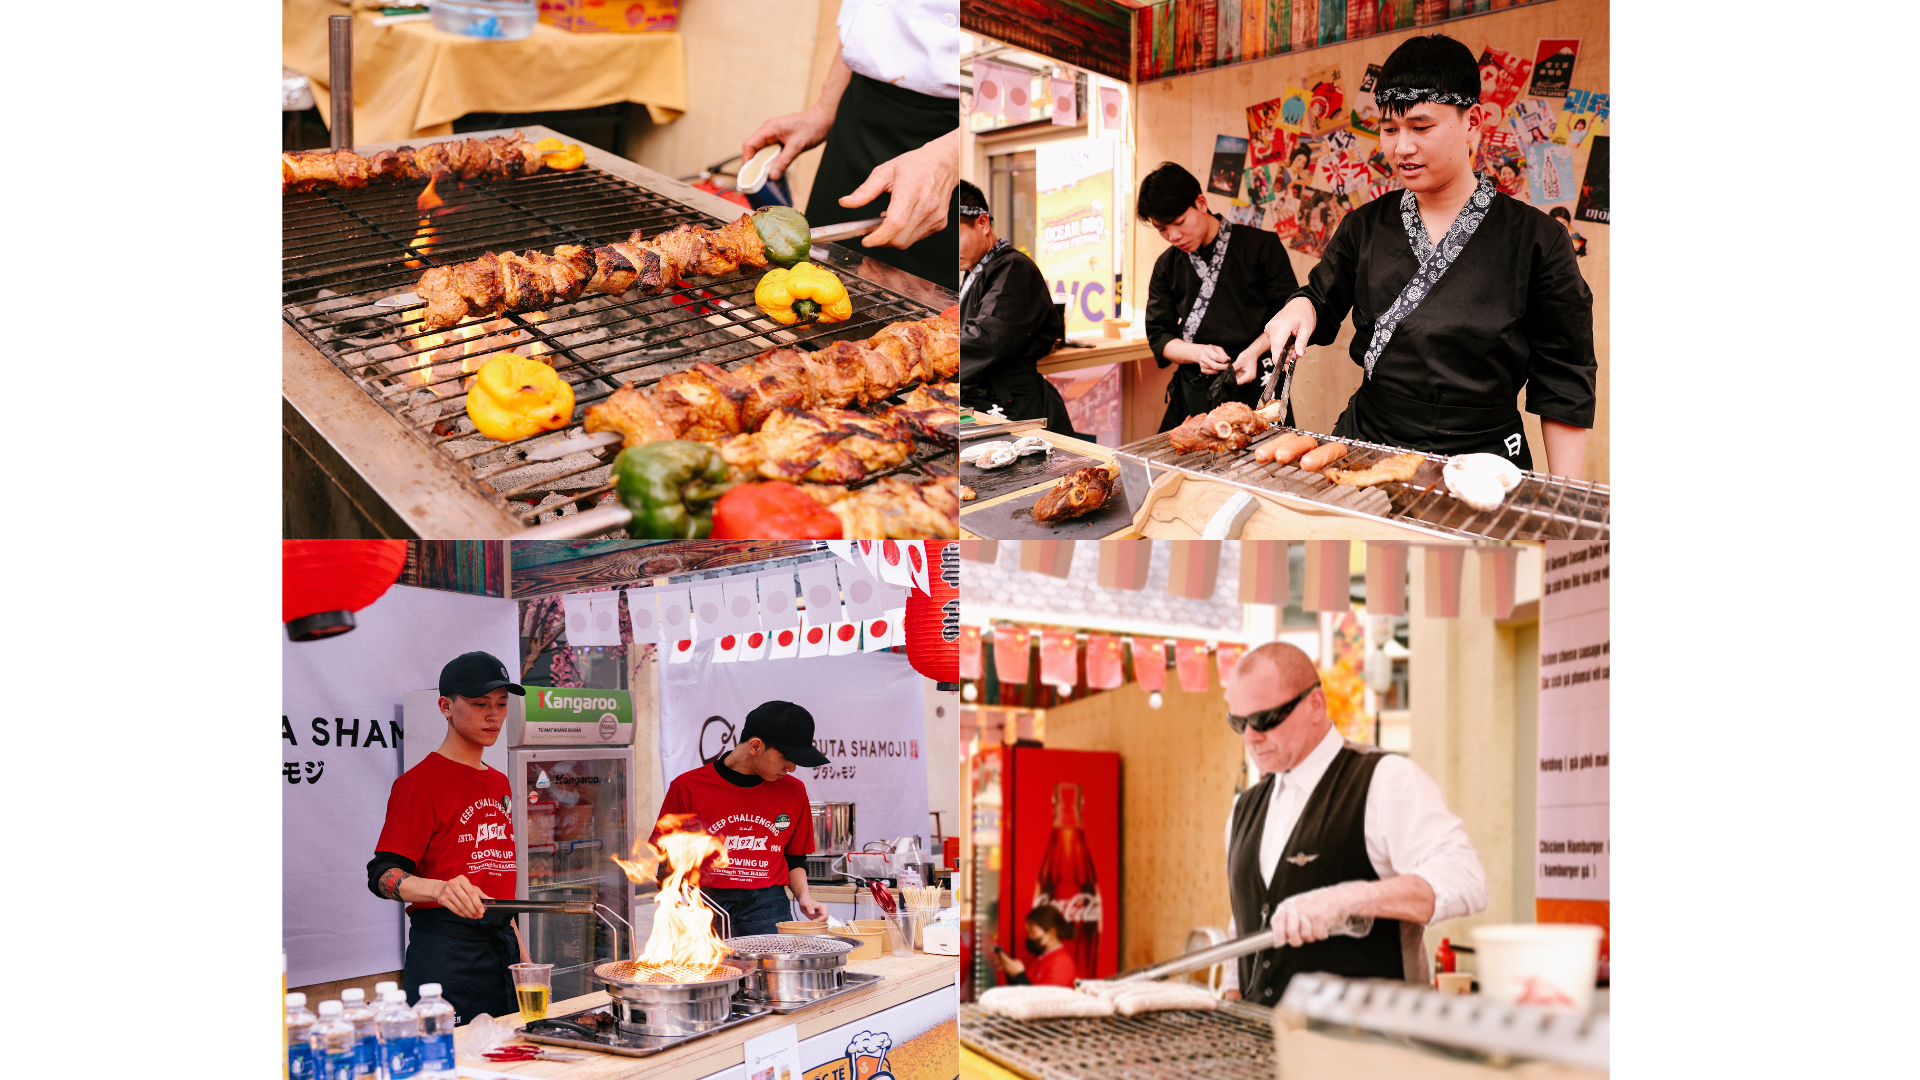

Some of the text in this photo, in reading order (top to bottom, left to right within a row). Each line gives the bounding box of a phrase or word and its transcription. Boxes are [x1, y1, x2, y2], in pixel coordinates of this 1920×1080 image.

[1044, 220, 1080, 242] OCEAN
[1082, 216, 1104, 235] BBQ
[1045, 280, 1106, 322] WC
[1503, 432, 1522, 456] 日
[852, 740, 907, 758] SHAMOJI
[1540, 758, 1563, 773] Hotdog
[459, 805, 474, 826] KEEP
[708, 818, 727, 835] KEEP
[727, 813, 780, 837] CHALLENGING
[740, 839, 751, 847] 97
[1540, 840, 1565, 854] Chicken
[1567, 840, 1604, 856] Hamburger
[503, 850, 514, 859] UP
[759, 860, 769, 868] UP
[1544, 864, 1580, 880] hamburger
